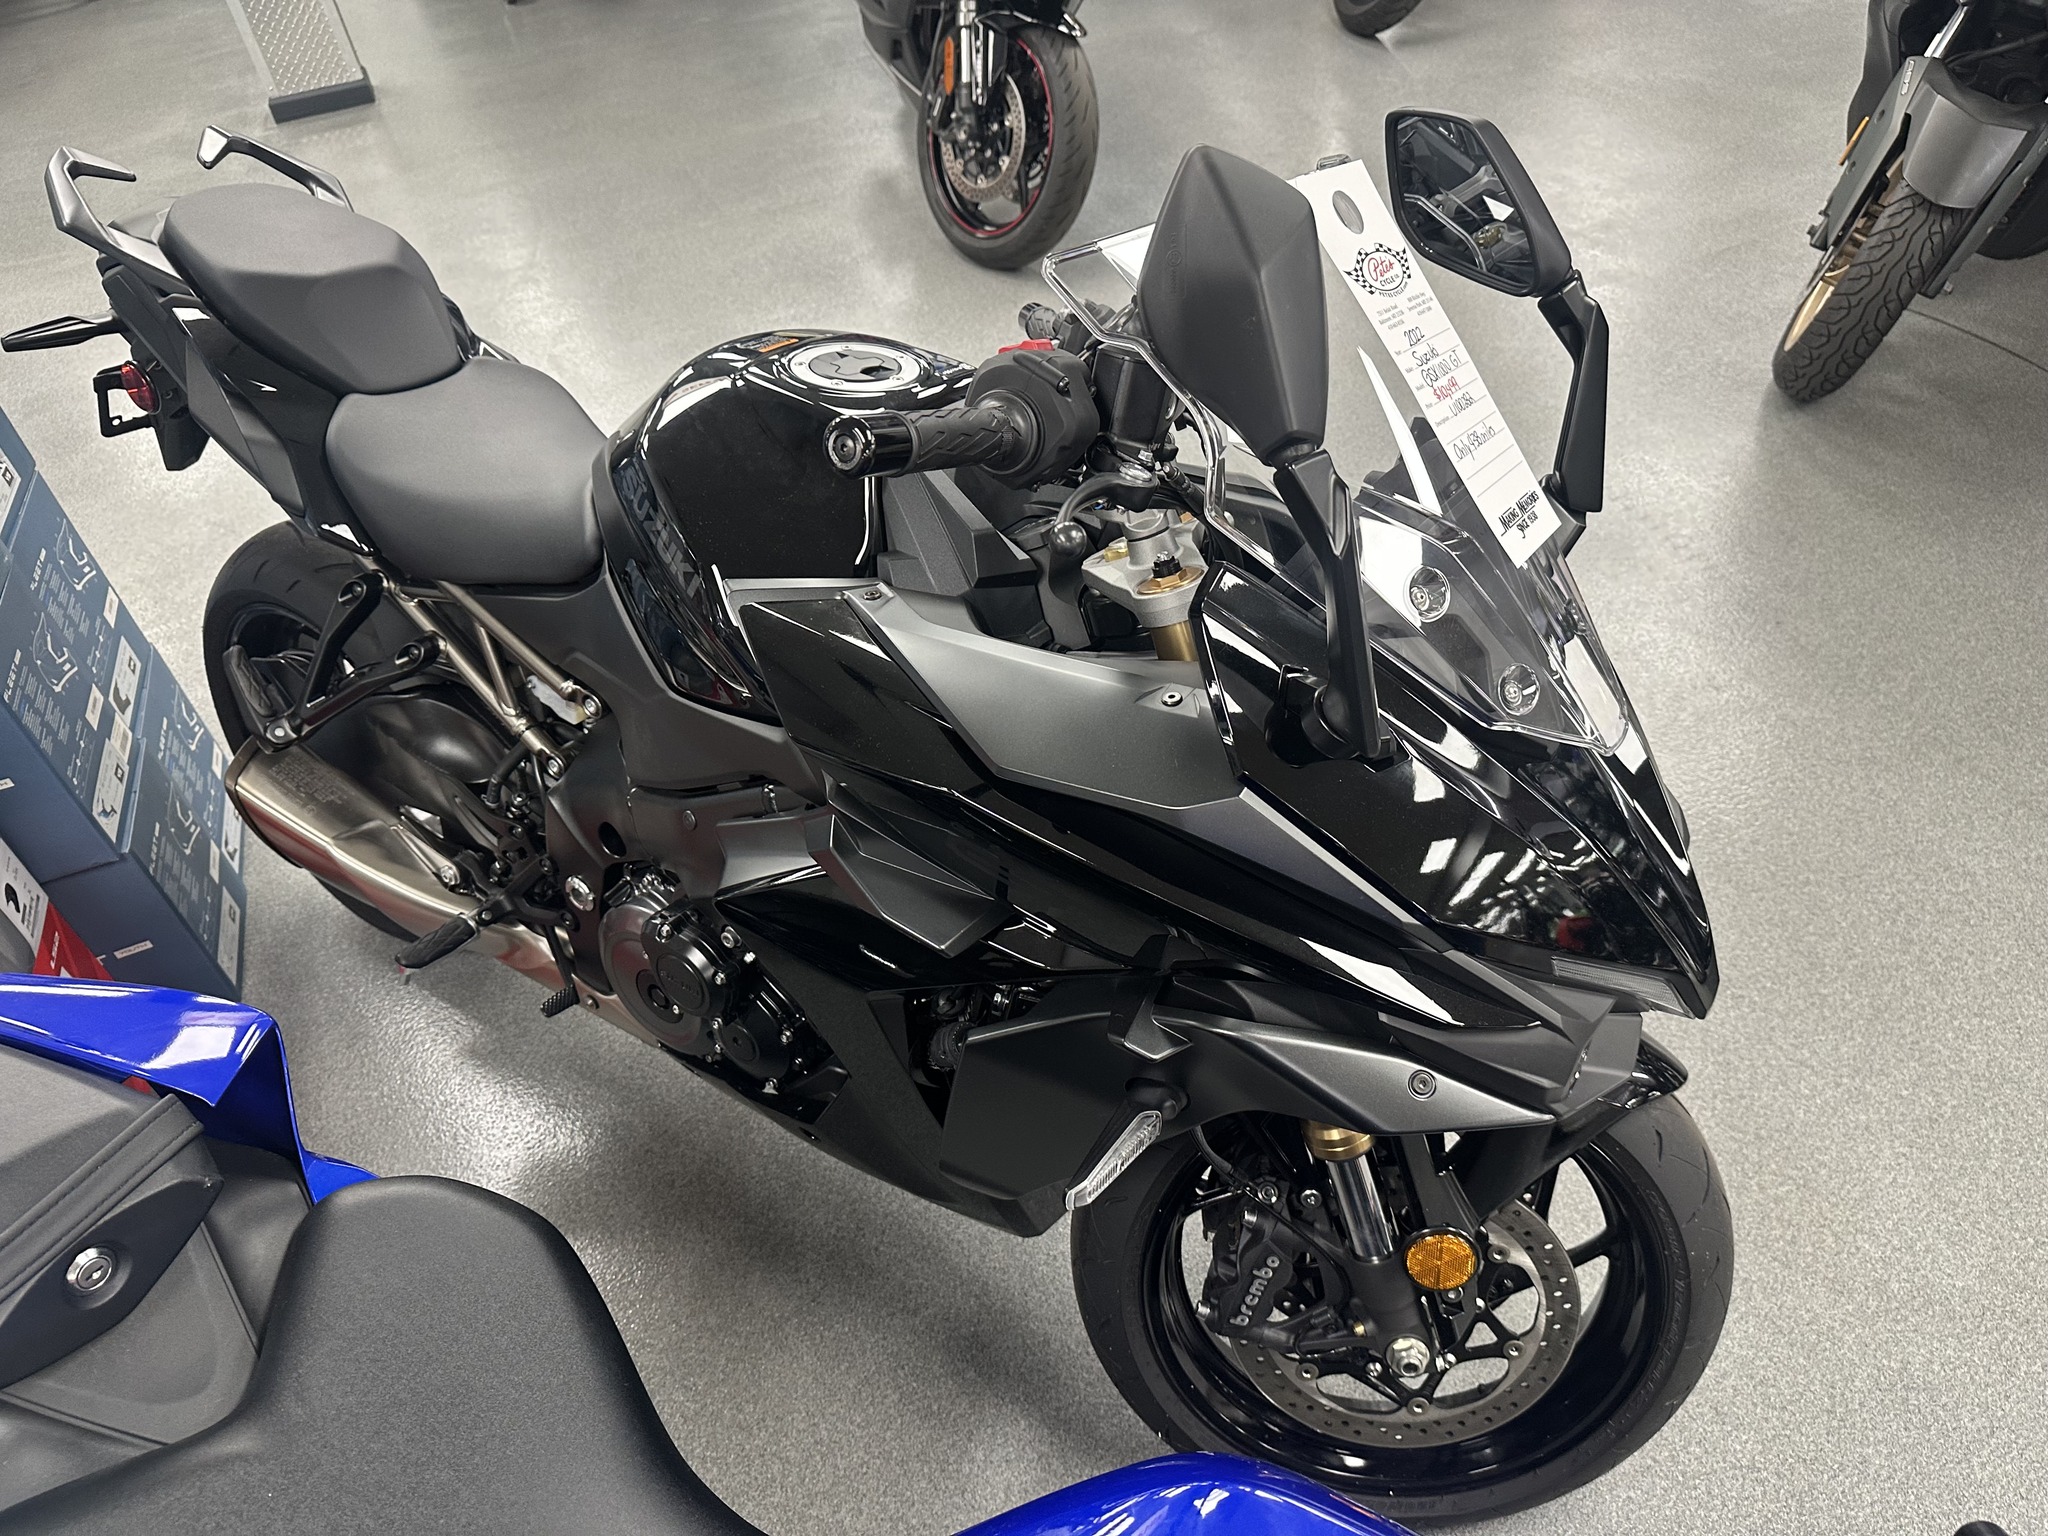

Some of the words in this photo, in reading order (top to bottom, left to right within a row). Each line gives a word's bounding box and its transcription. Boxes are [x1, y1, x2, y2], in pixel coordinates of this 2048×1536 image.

[1380, 275, 1395, 287] CYCLE
[1403, 326, 1425, 347] 2022
[1412, 342, 1439, 367] Suzuki
[1449, 349, 1461, 368] GT
[1453, 438, 1475, 461] Only
[622, 464, 700, 600] SUZUKI
[3, 660, 20, 703] FLEET
[1229, 1255, 1280, 1327] brembo
